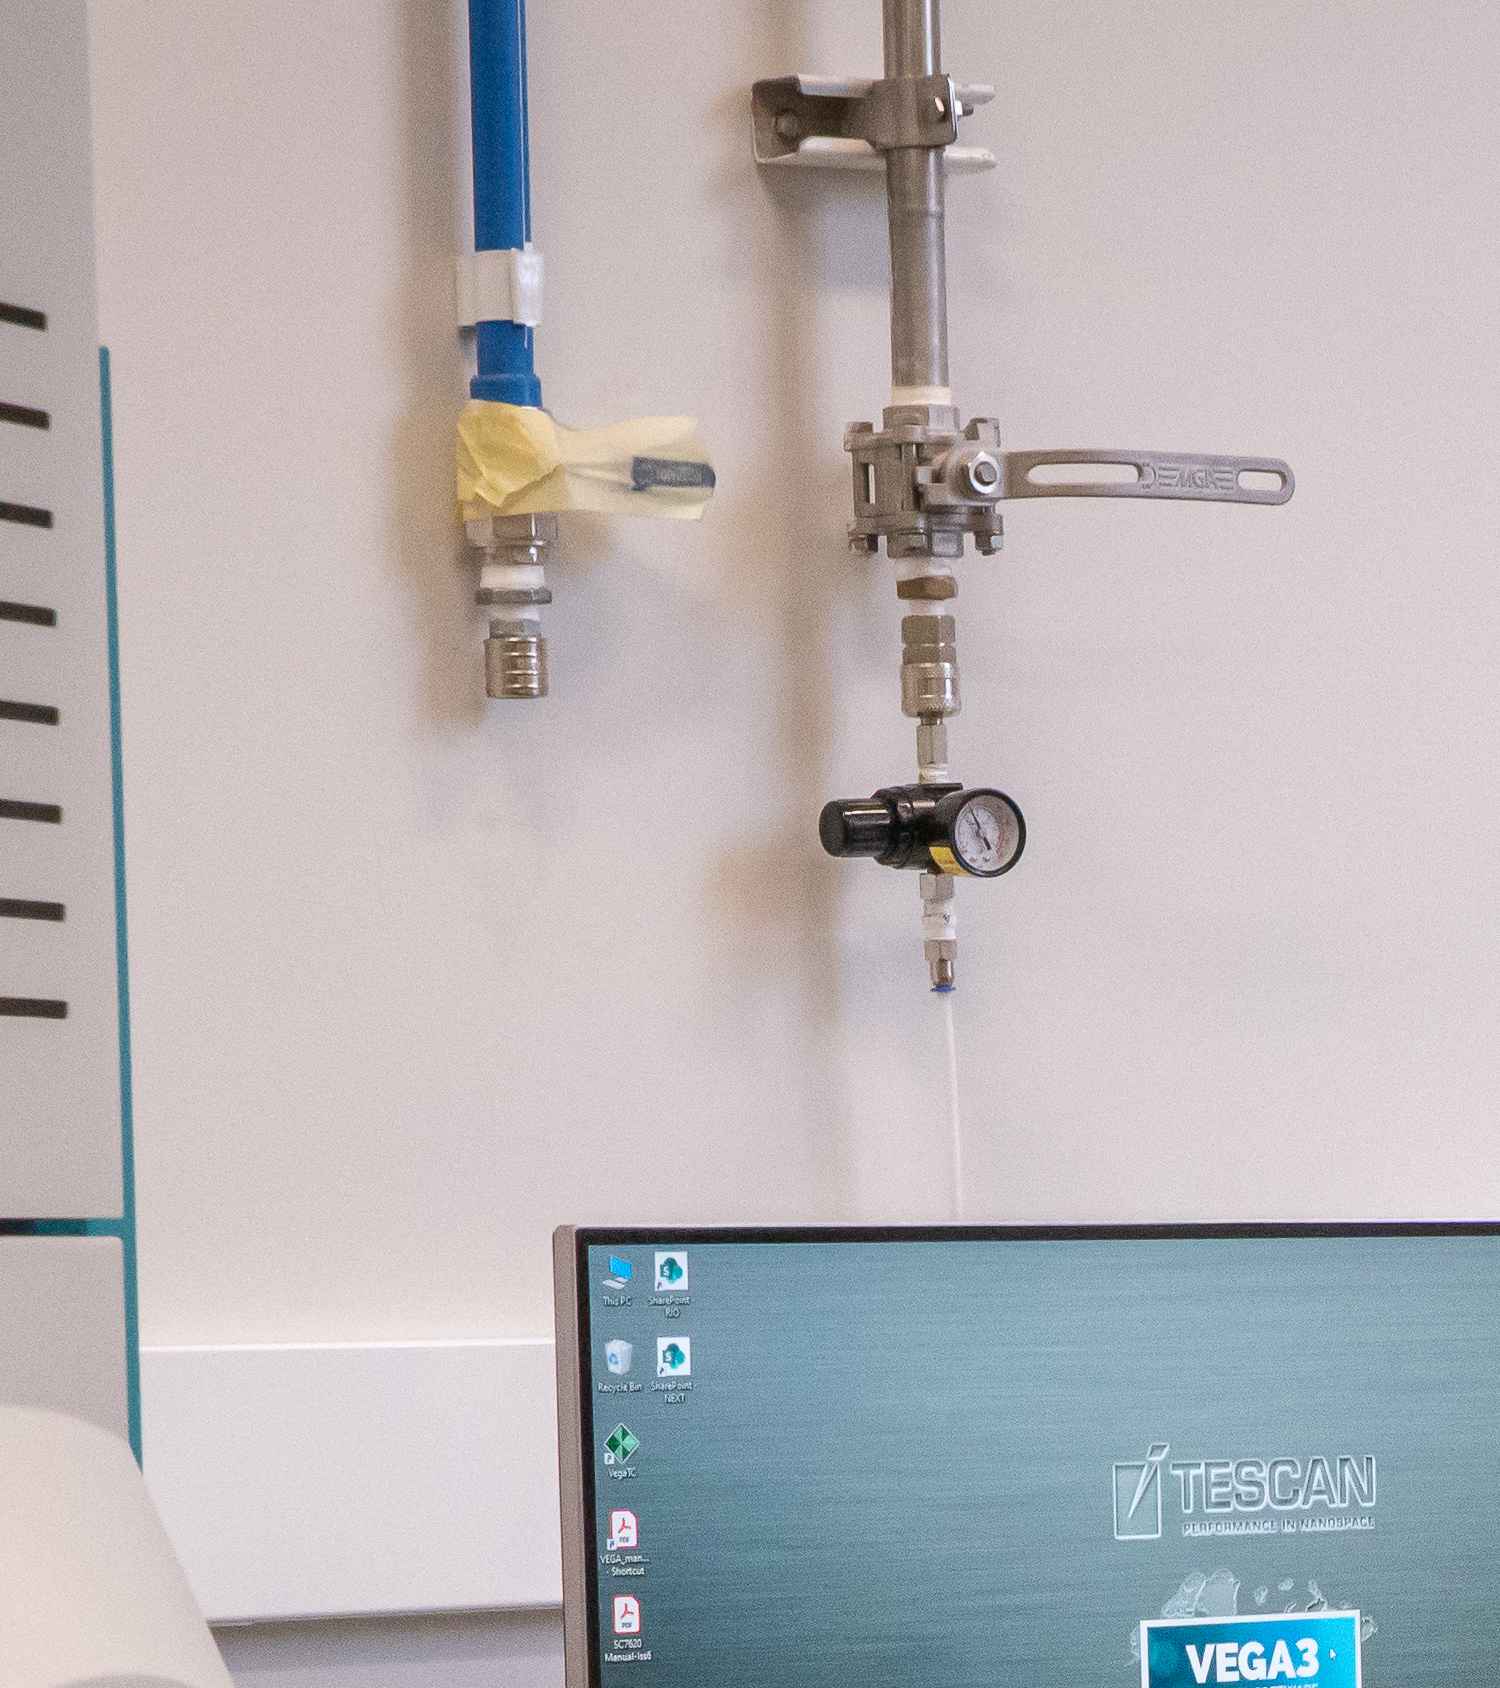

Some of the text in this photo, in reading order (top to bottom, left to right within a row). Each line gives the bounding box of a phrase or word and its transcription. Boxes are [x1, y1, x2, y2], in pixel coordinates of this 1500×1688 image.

[651, 1381, 692, 1392] SharePoint
[664, 1393, 685, 1403] NEXT
[1170, 1455, 1376, 1513] TESCAN
[1183, 1516, 1375, 1536] PERFORMANCE IN NANOSPACE
[1186, 1637, 1319, 1683] VEGA3
